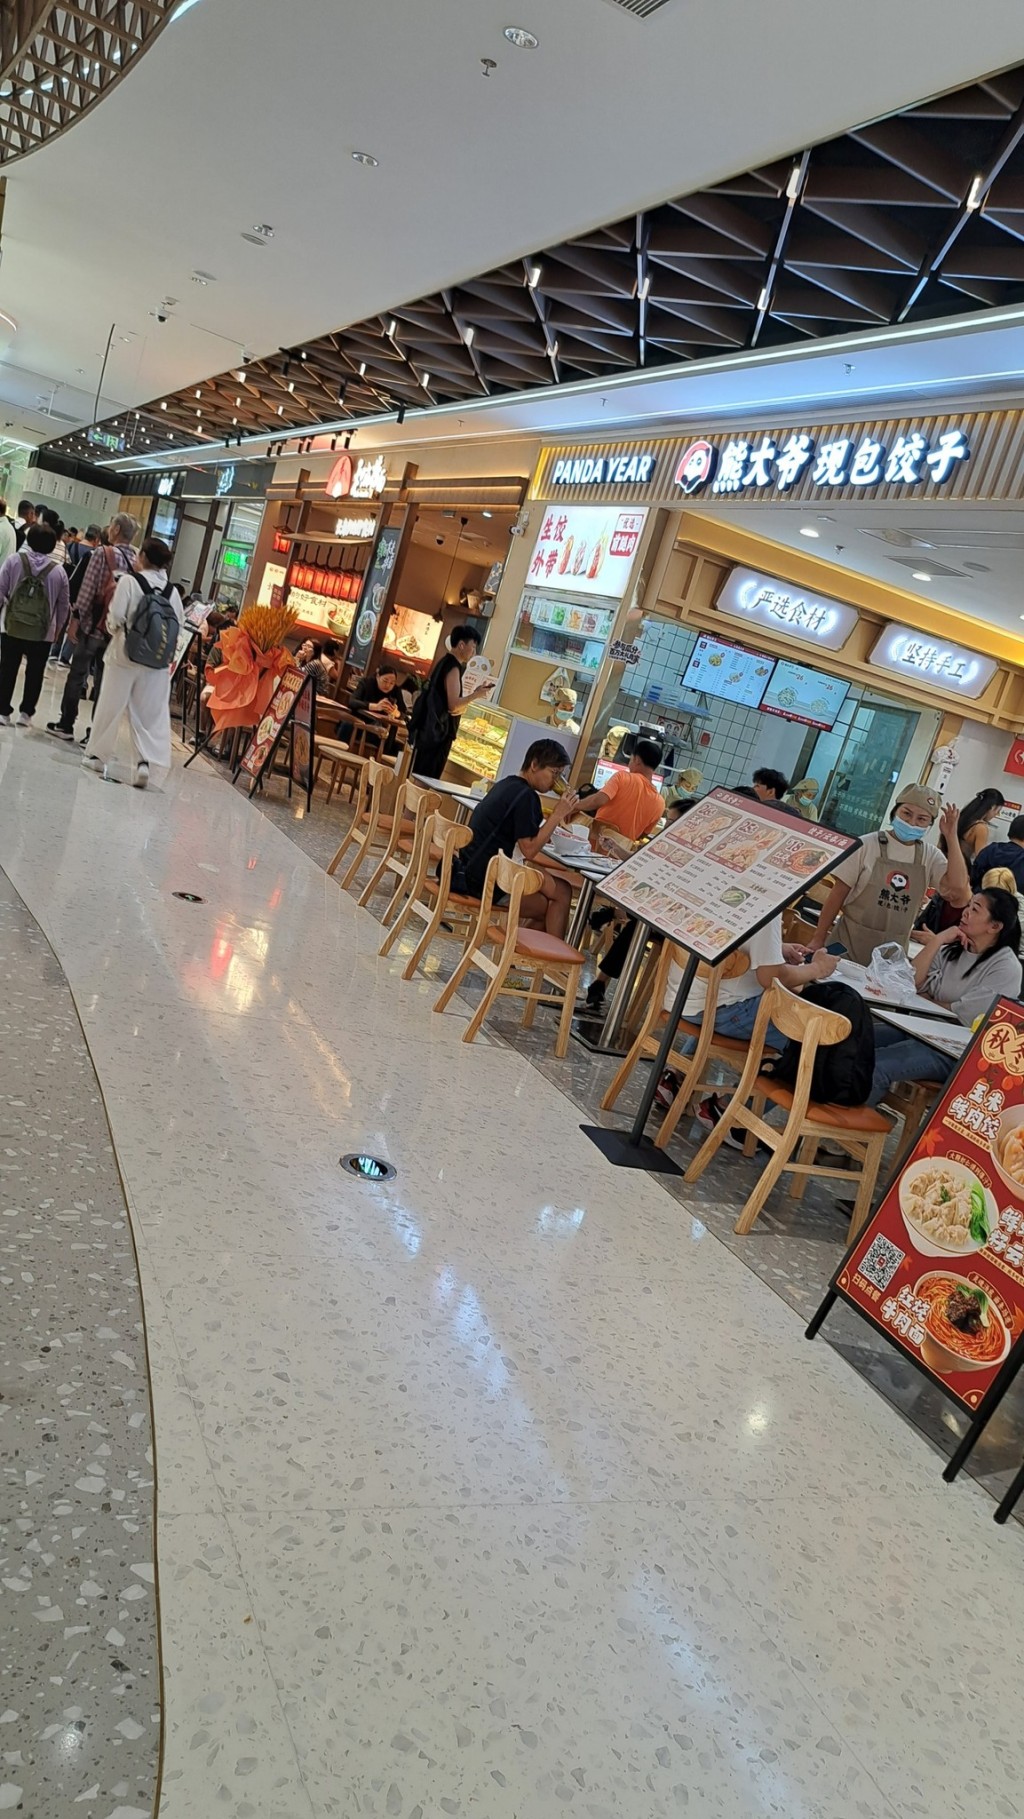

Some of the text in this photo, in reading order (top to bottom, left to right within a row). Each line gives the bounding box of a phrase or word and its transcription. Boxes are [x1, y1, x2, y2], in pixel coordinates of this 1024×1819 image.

[552, 456, 653, 484] PANDA YEAR
[711, 430, 966, 494] 熊大爷 现包饺子
[541, 513, 568, 542] 生饺
[531, 549, 558, 578] 外带
[751, 590, 826, 631] 严选食材
[901, 642, 967, 679] 坚持手工
[967, 1083, 1003, 1112] 玉米
[950, 1097, 1000, 1139] 鲜肉饺
[852, 1273, 881, 1303] 扫码点餐
[898, 1286, 931, 1322] 红烧
[882, 1299, 926, 1345] 牛肉面
